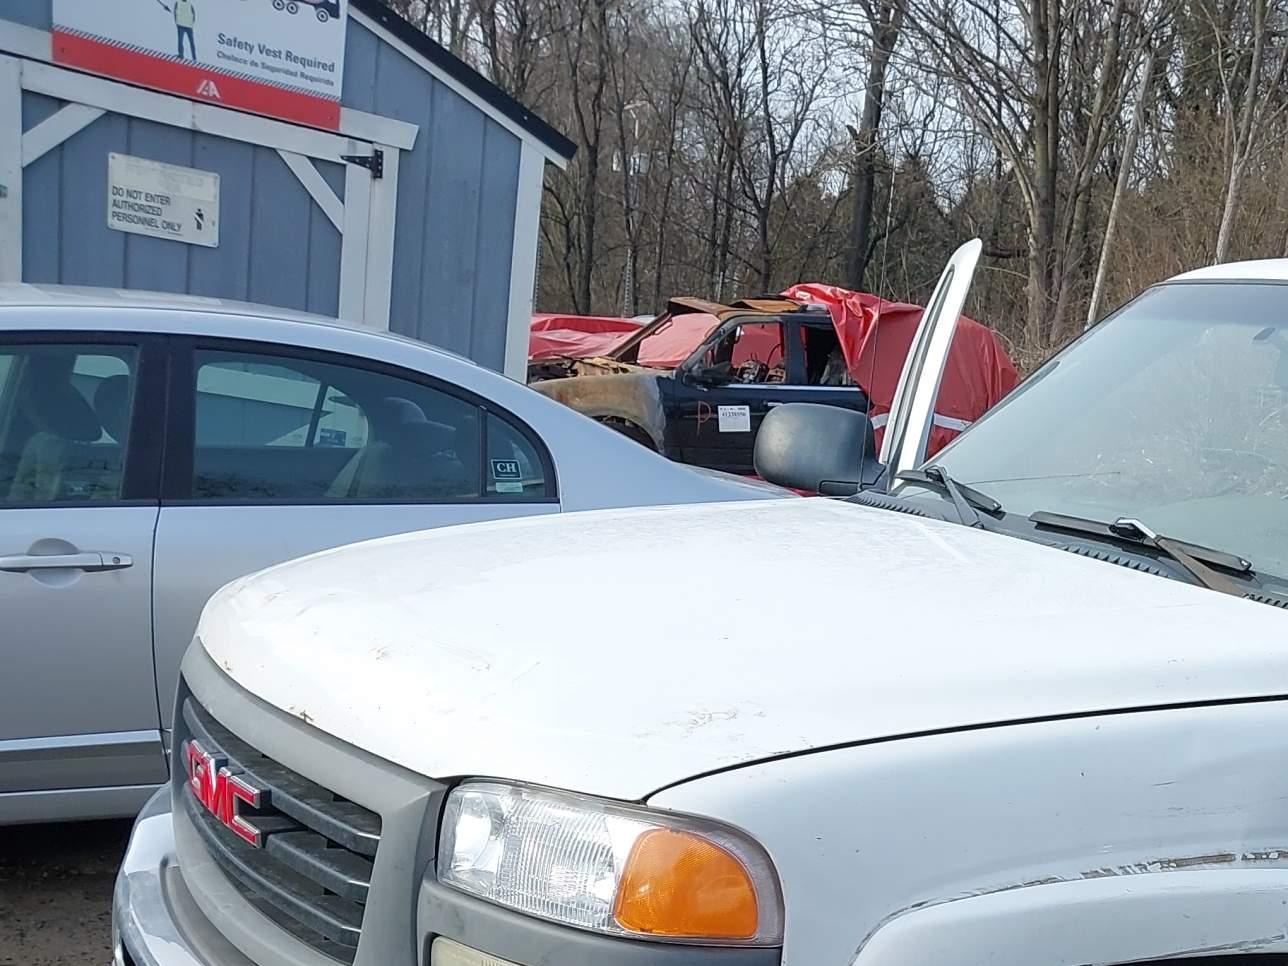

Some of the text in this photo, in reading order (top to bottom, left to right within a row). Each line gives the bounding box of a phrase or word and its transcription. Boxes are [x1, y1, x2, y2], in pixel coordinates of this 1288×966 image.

[217, 32, 335, 72] Safety Vest Required
[112, 185, 171, 206] DO NOT ENTER
[112, 199, 163, 217] AUTHORIZED
[111, 210, 182, 232] PERSONNEL ONLY
[496, 462, 517, 473] CH
[186, 739, 261, 849] GMC
